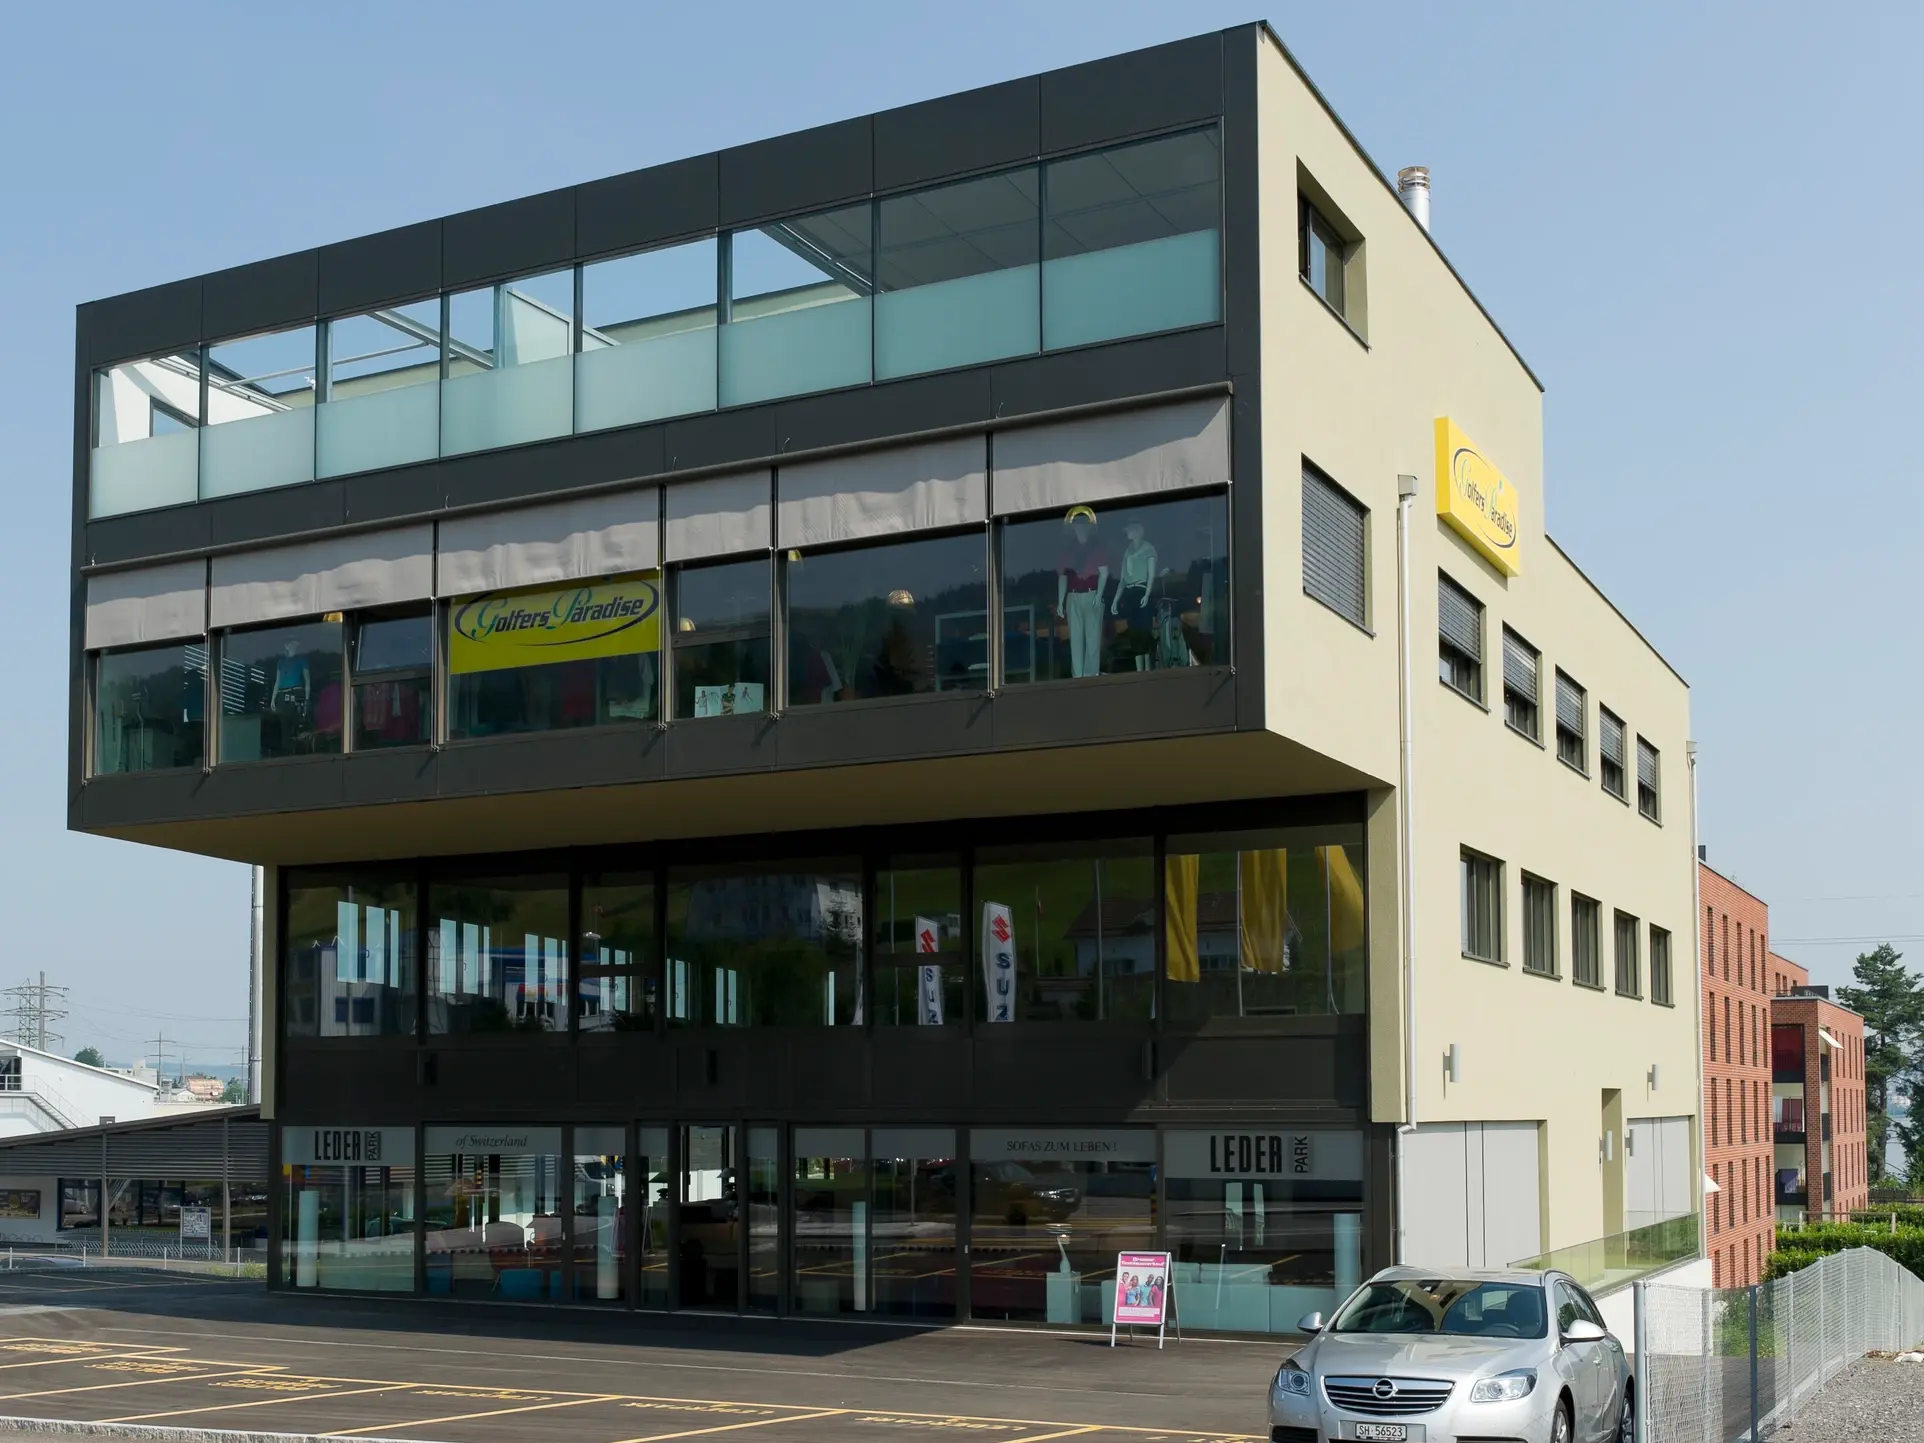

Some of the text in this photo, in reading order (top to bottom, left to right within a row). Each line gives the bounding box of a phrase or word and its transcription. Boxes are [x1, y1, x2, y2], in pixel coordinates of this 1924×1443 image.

[1459, 459, 1513, 539] Golfers Paradise
[471, 587, 645, 640] Golfers Paradise
[314, 1130, 361, 1161] LEDER
[367, 1130, 379, 1161] PARK
[456, 1134, 529, 1149] of Switzerland
[1006, 1140, 1041, 1151] SOFAS
[1043, 1141, 1070, 1152] ZUM
[1210, 1135, 1282, 1173] LEDER
[1294, 1135, 1308, 1174] PARK
[1359, 1425, 1403, 1437] SH 56523
